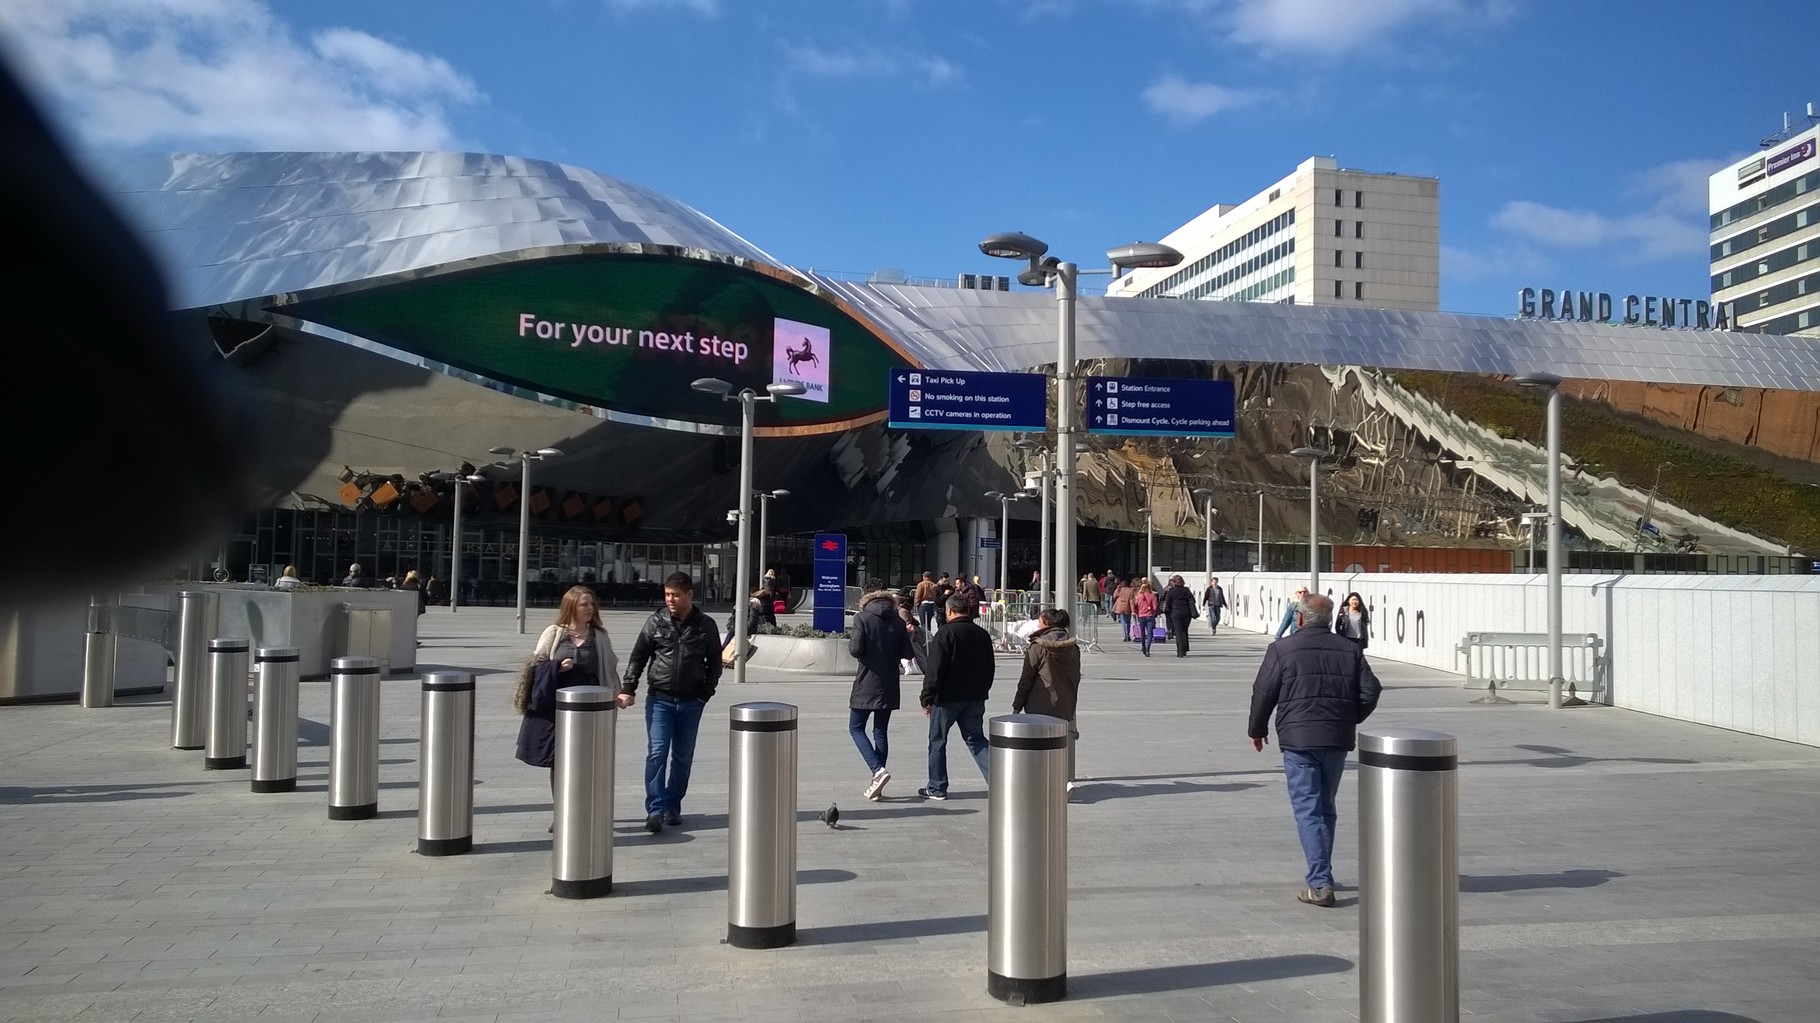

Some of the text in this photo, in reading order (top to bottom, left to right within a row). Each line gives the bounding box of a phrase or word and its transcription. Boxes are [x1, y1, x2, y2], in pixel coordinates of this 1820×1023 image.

[1768, 151, 1801, 171] Premier Inn
[1518, 287, 1743, 332] GRAND CENTRAL
[518, 313, 749, 365] For your next step
[925, 376, 966, 386] Taxi Pick Up
[806, 382, 824, 392] BANK
[1121, 384, 1171, 393] Station Entrance
[925, 393, 935, 401] No
[936, 393, 963, 403] smoking
[974, 394, 986, 402] this
[1121, 400, 1136, 409] Step
[1137, 400, 1150, 409] free
[924, 409, 944, 417] CCTV
[973, 410, 980, 418] in
[981, 411, 1012, 420] operation
[1121, 416, 1151, 424] Dismount
[1171, 417, 1188, 426] Cycle
[1188, 418, 1211, 427] parking
[1212, 418, 1230, 427] ahead
